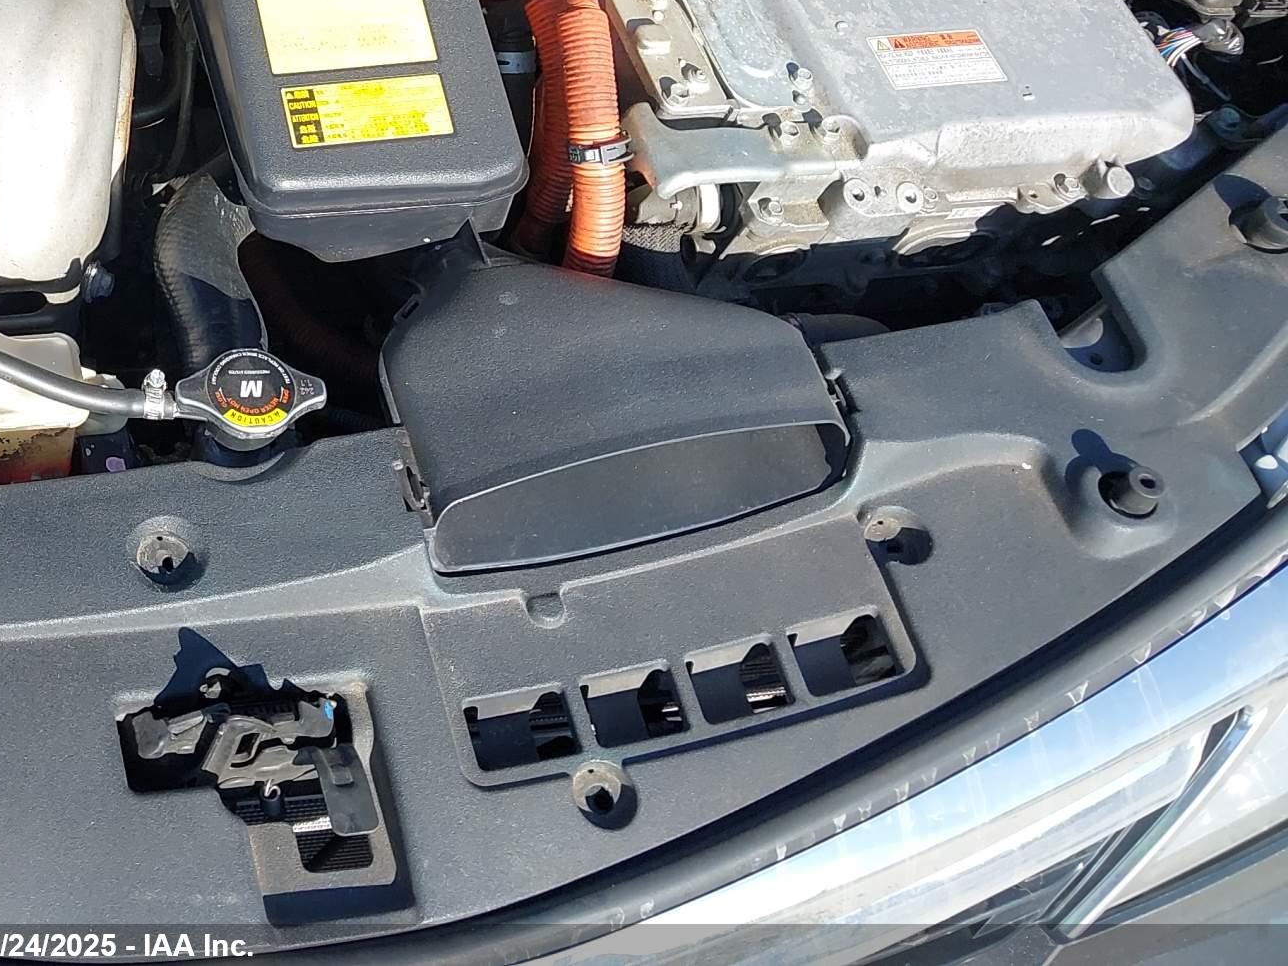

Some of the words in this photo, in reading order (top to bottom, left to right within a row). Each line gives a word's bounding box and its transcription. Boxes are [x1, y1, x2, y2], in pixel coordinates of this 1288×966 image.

[288, 100, 317, 110] CAUTION
[219, 352, 241, 366] CHANGING
[258, 353, 278, 367] REPLACE
[211, 364, 221, 384] COOLANT
[239, 380, 262, 398] M
[226, 396, 240, 410] HOT
[239, 405, 258, 414] OPEN
[258, 396, 278, 413] NEVER
[230, 412, 274, 424] CAUTION
